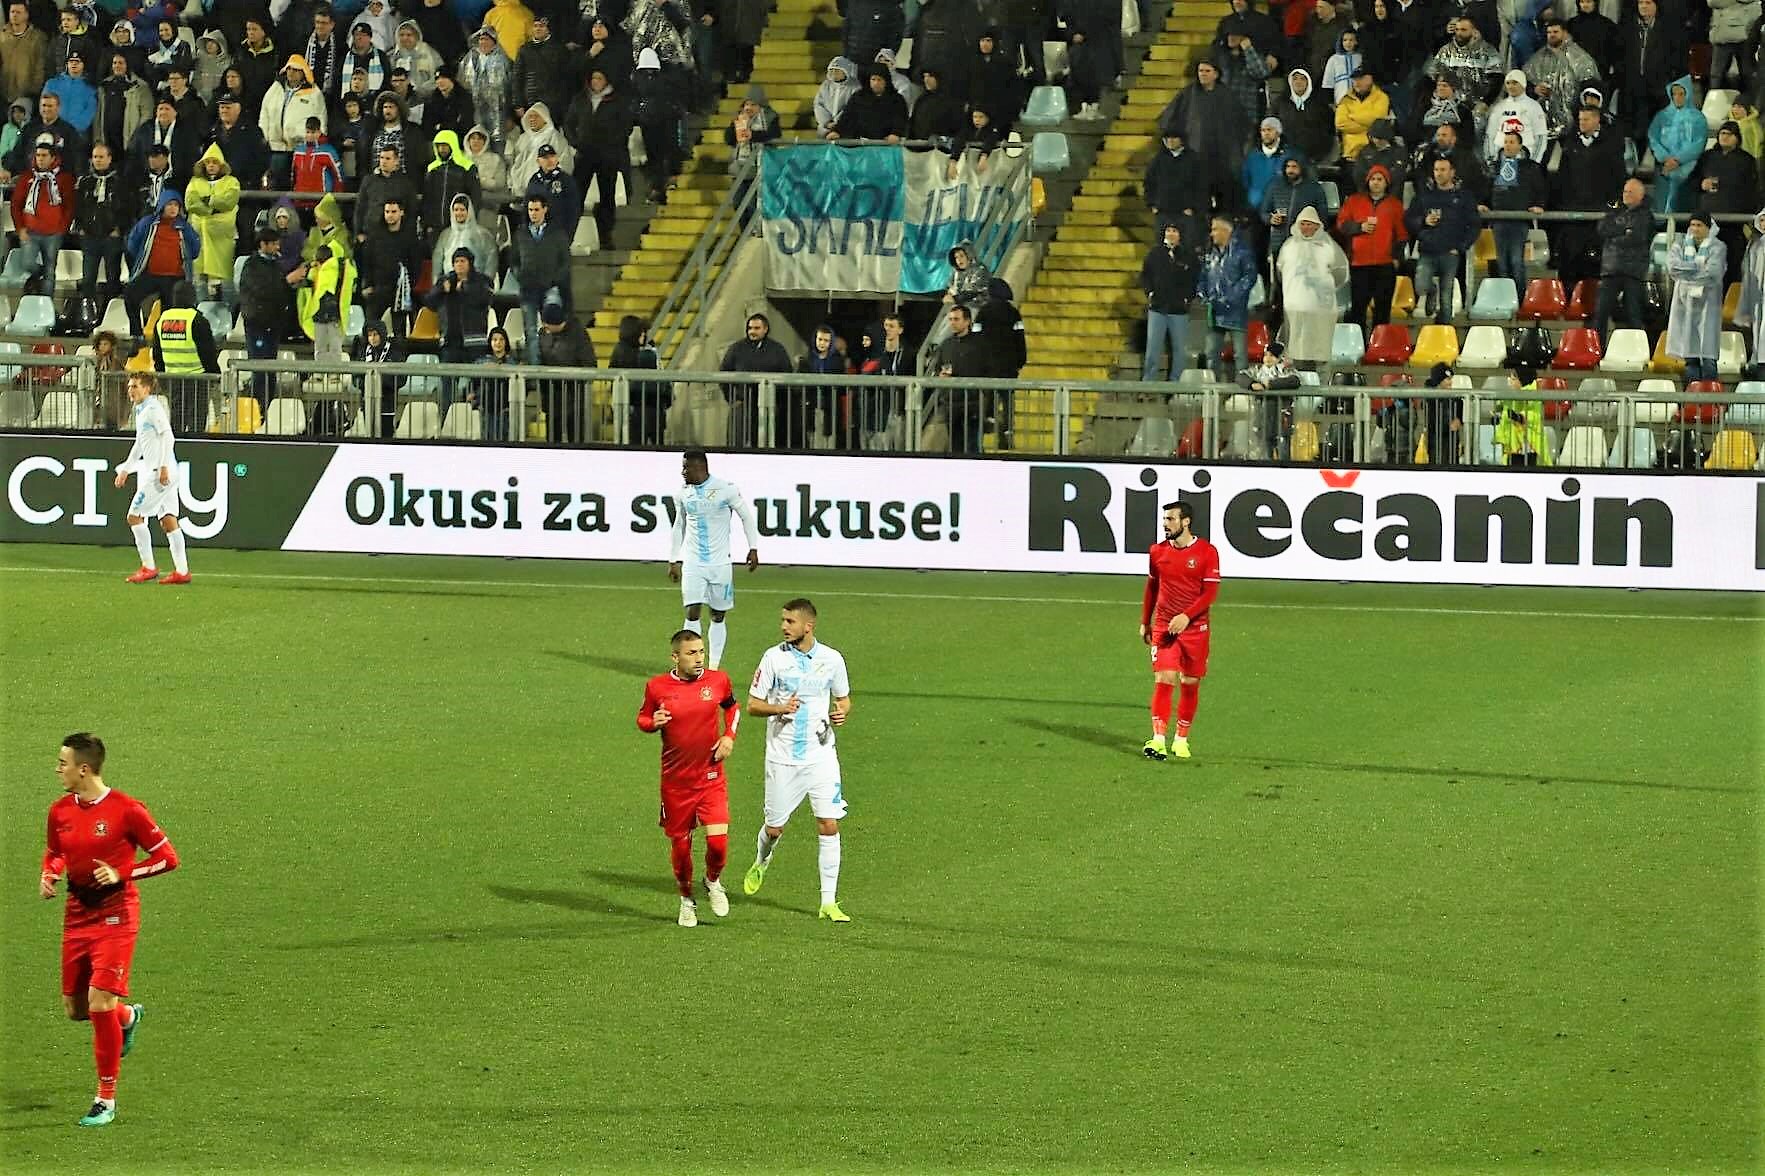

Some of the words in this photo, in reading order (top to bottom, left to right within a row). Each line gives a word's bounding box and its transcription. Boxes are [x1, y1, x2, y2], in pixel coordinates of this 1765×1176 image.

[7, 456, 229, 540] CIy
[345, 473, 522, 530] Okusi
[542, 492, 611, 533] za
[753, 484, 960, 543] ukuse!
[1028, 465, 1674, 568] Riječanin
